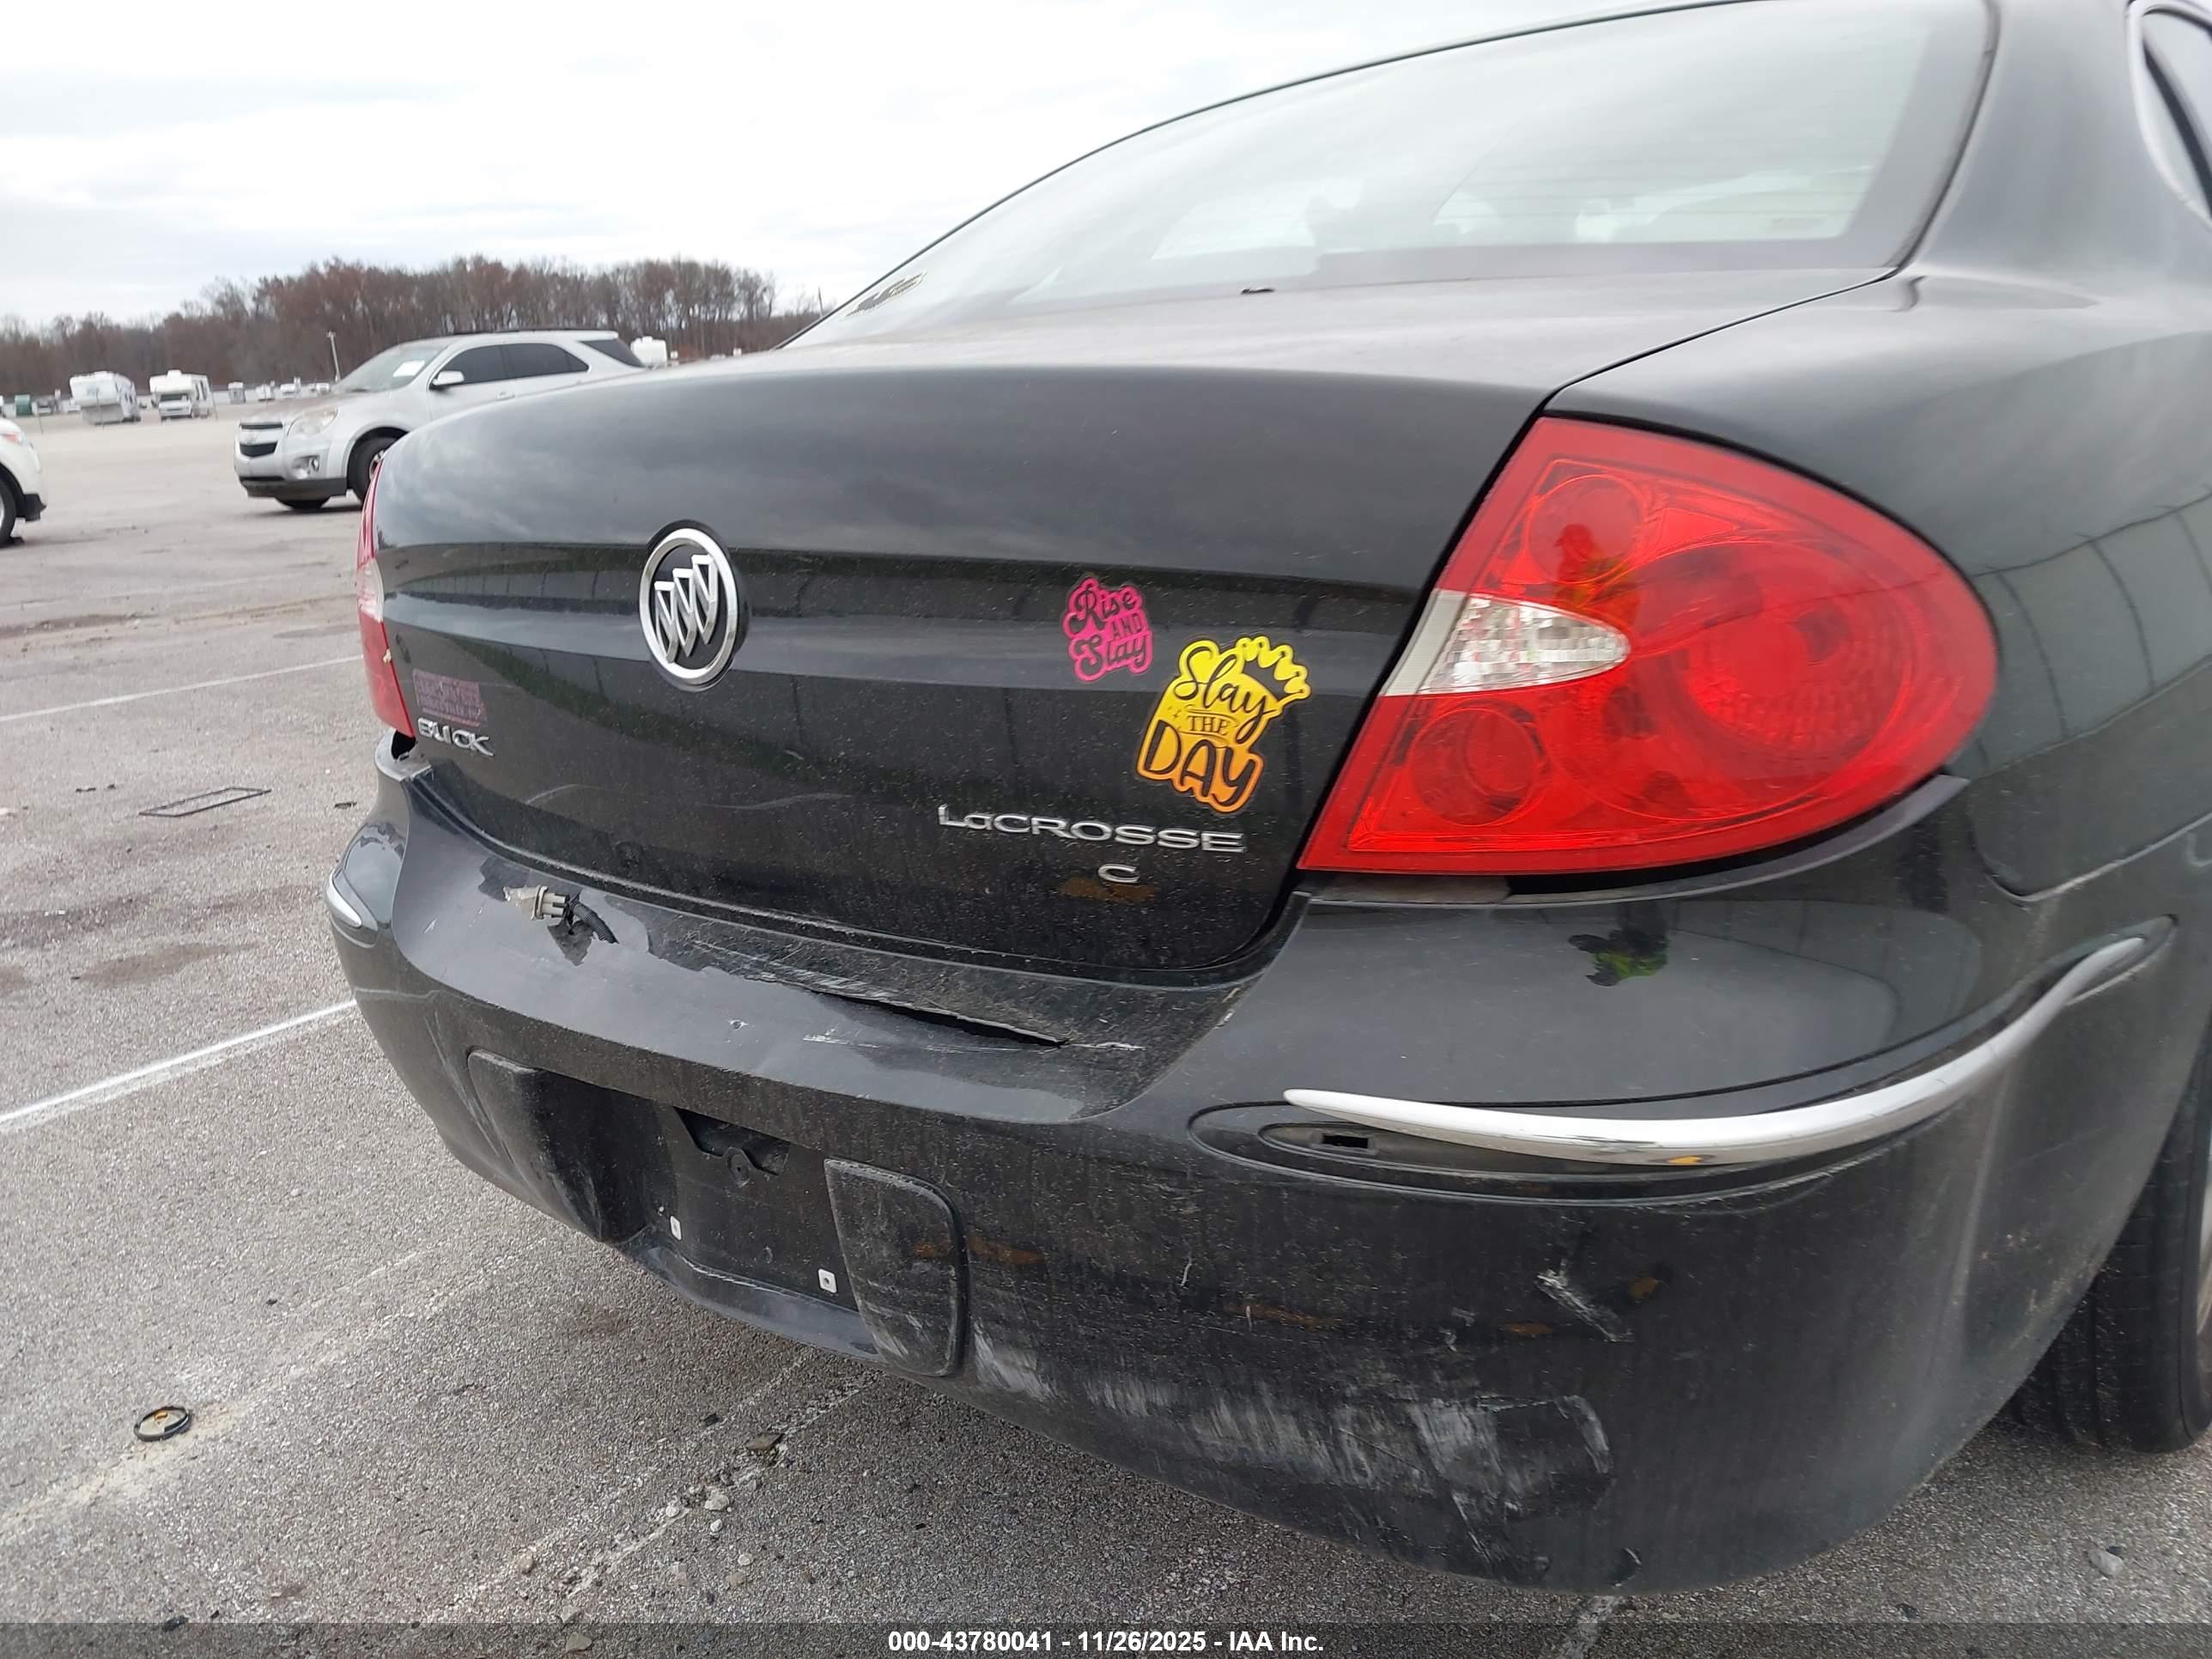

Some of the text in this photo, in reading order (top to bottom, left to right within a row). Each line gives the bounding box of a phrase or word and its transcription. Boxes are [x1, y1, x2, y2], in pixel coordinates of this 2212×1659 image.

[1069, 583, 1137, 634] Rise
[1110, 612, 1143, 640] AND
[1074, 634, 1147, 676] Slay
[1174, 646, 1278, 744] Slay
[1187, 714, 1231, 737] THE
[1143, 719, 1256, 805] DAY
[938, 803, 1246, 854] LaCROSSE
[1097, 863, 1140, 884] C
